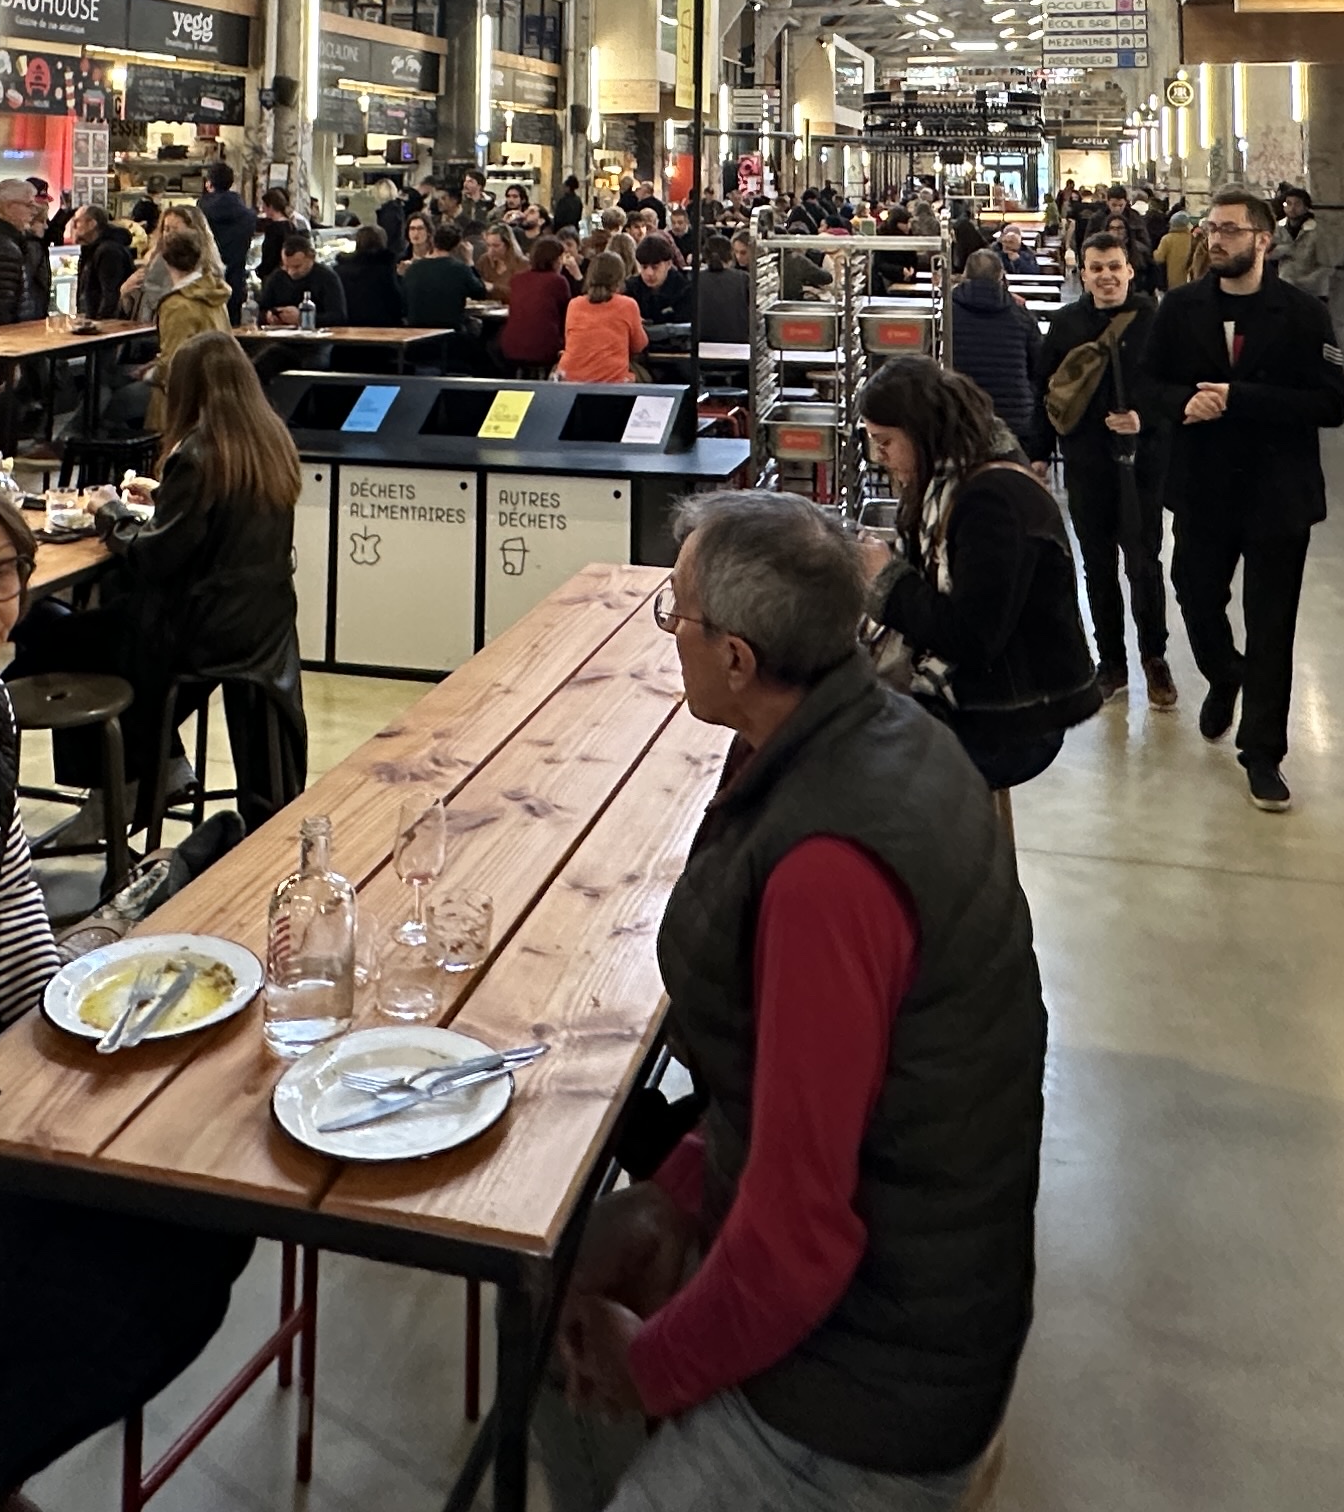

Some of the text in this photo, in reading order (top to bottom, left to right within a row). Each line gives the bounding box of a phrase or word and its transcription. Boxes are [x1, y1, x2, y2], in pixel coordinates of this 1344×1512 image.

[1046, 0, 1111, 11] ACCUEIL
[172, 10, 214, 42] yegg
[349, 478, 416, 500] DÉCHETS
[498, 489, 561, 508] AUTRES
[349, 503, 466, 525] ALIMENTAIRES
[498, 508, 567, 530] DÉCHETS
